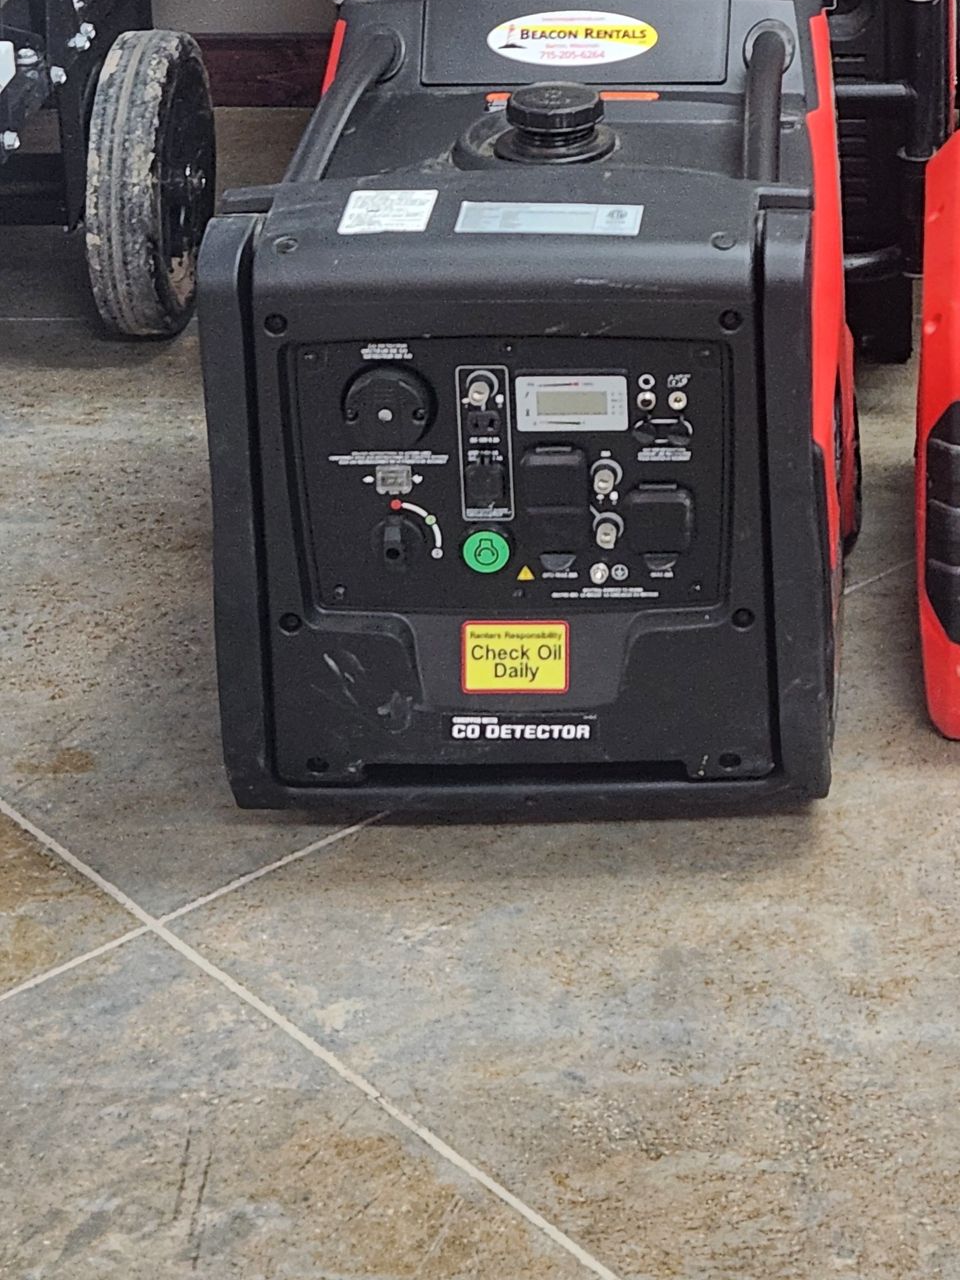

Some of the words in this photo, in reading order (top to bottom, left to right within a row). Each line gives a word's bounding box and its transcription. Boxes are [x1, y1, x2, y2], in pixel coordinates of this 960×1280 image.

[520, 28, 579, 40] BEACON
[584, 27, 648, 40] RENTALS
[540, 50, 606, 60] 715-205-6264
[471, 644, 531, 661] Check
[537, 644, 562, 661] Oil
[494, 662, 540, 683] Daily
[452, 724, 480, 739] CO
[485, 724, 591, 739] DETECTOR
